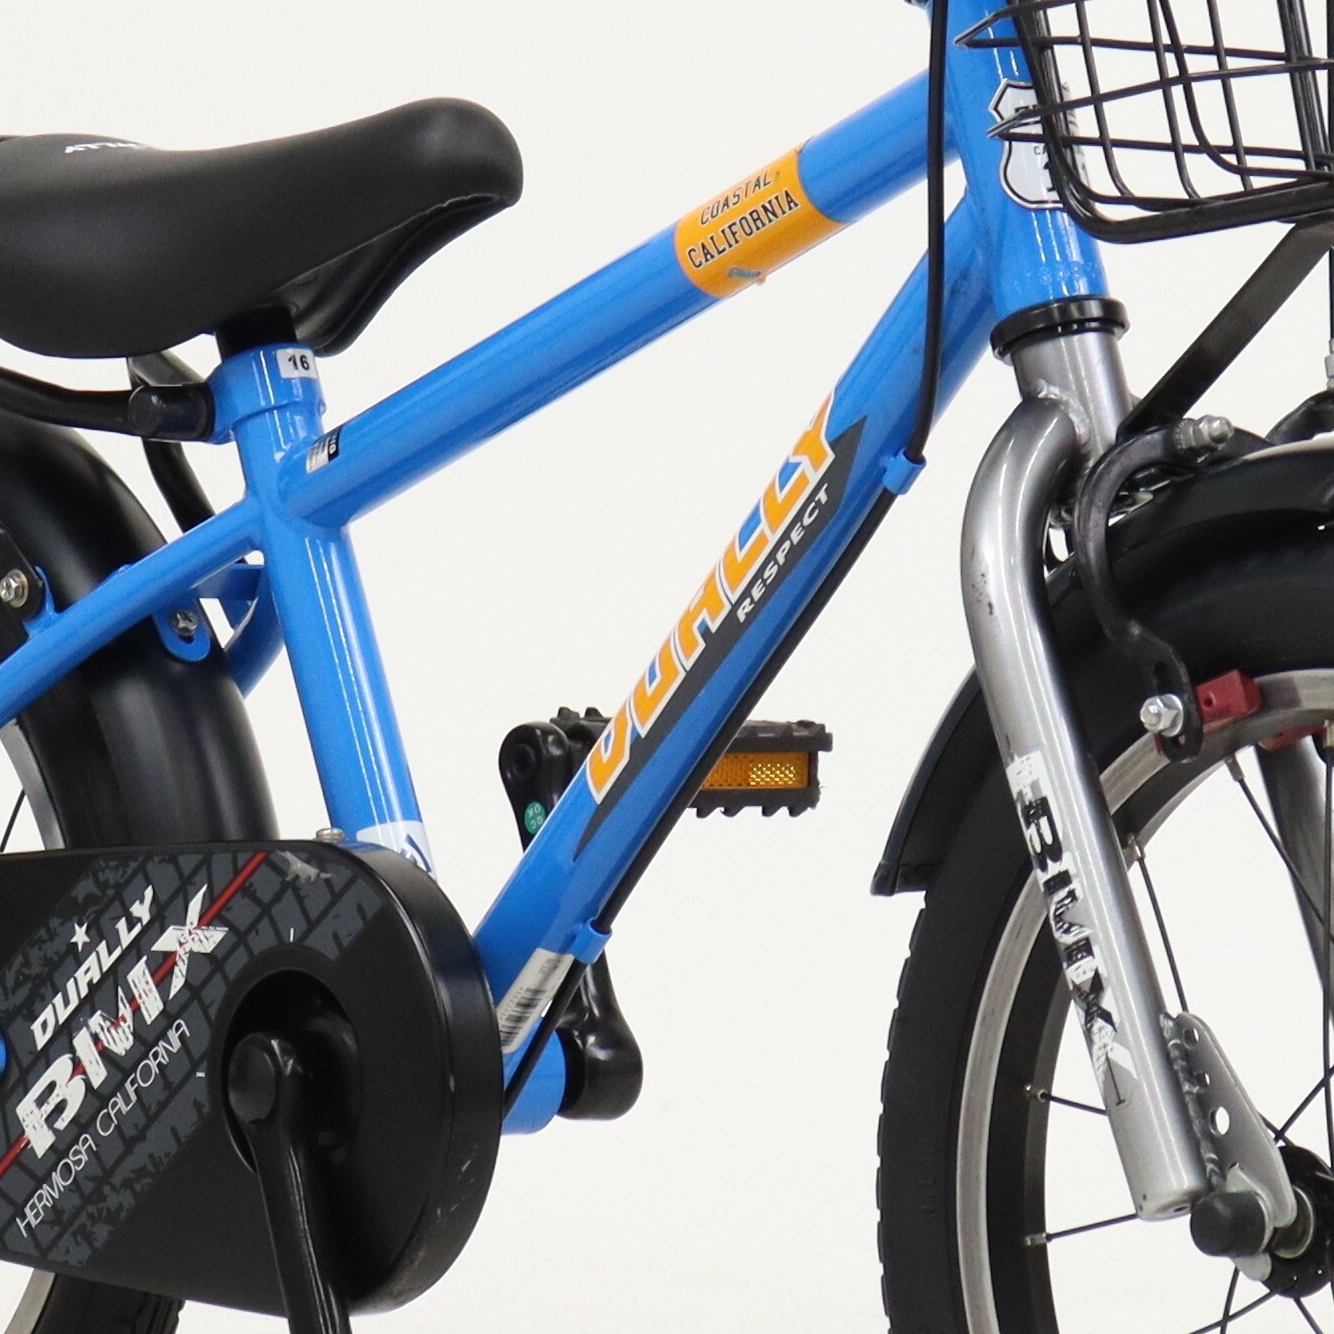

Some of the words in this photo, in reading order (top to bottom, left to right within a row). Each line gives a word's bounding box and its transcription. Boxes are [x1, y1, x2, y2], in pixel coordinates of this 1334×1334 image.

[687, 189, 799, 268] CALIFORNIA
[700, 170, 772, 225] COASTAL
[288, 354, 310, 371] 16
[586, 389, 836, 805] DUALLY
[736, 472, 829, 623] RESPECT
[30, 884, 154, 1052] DUALLY
[1017, 782, 1123, 1057] BMX
[15, 883, 230, 1160] BMX
[16, 1133, 97, 1238] HERMOSA
[96, 1018, 191, 1137] CALIFORNIA
